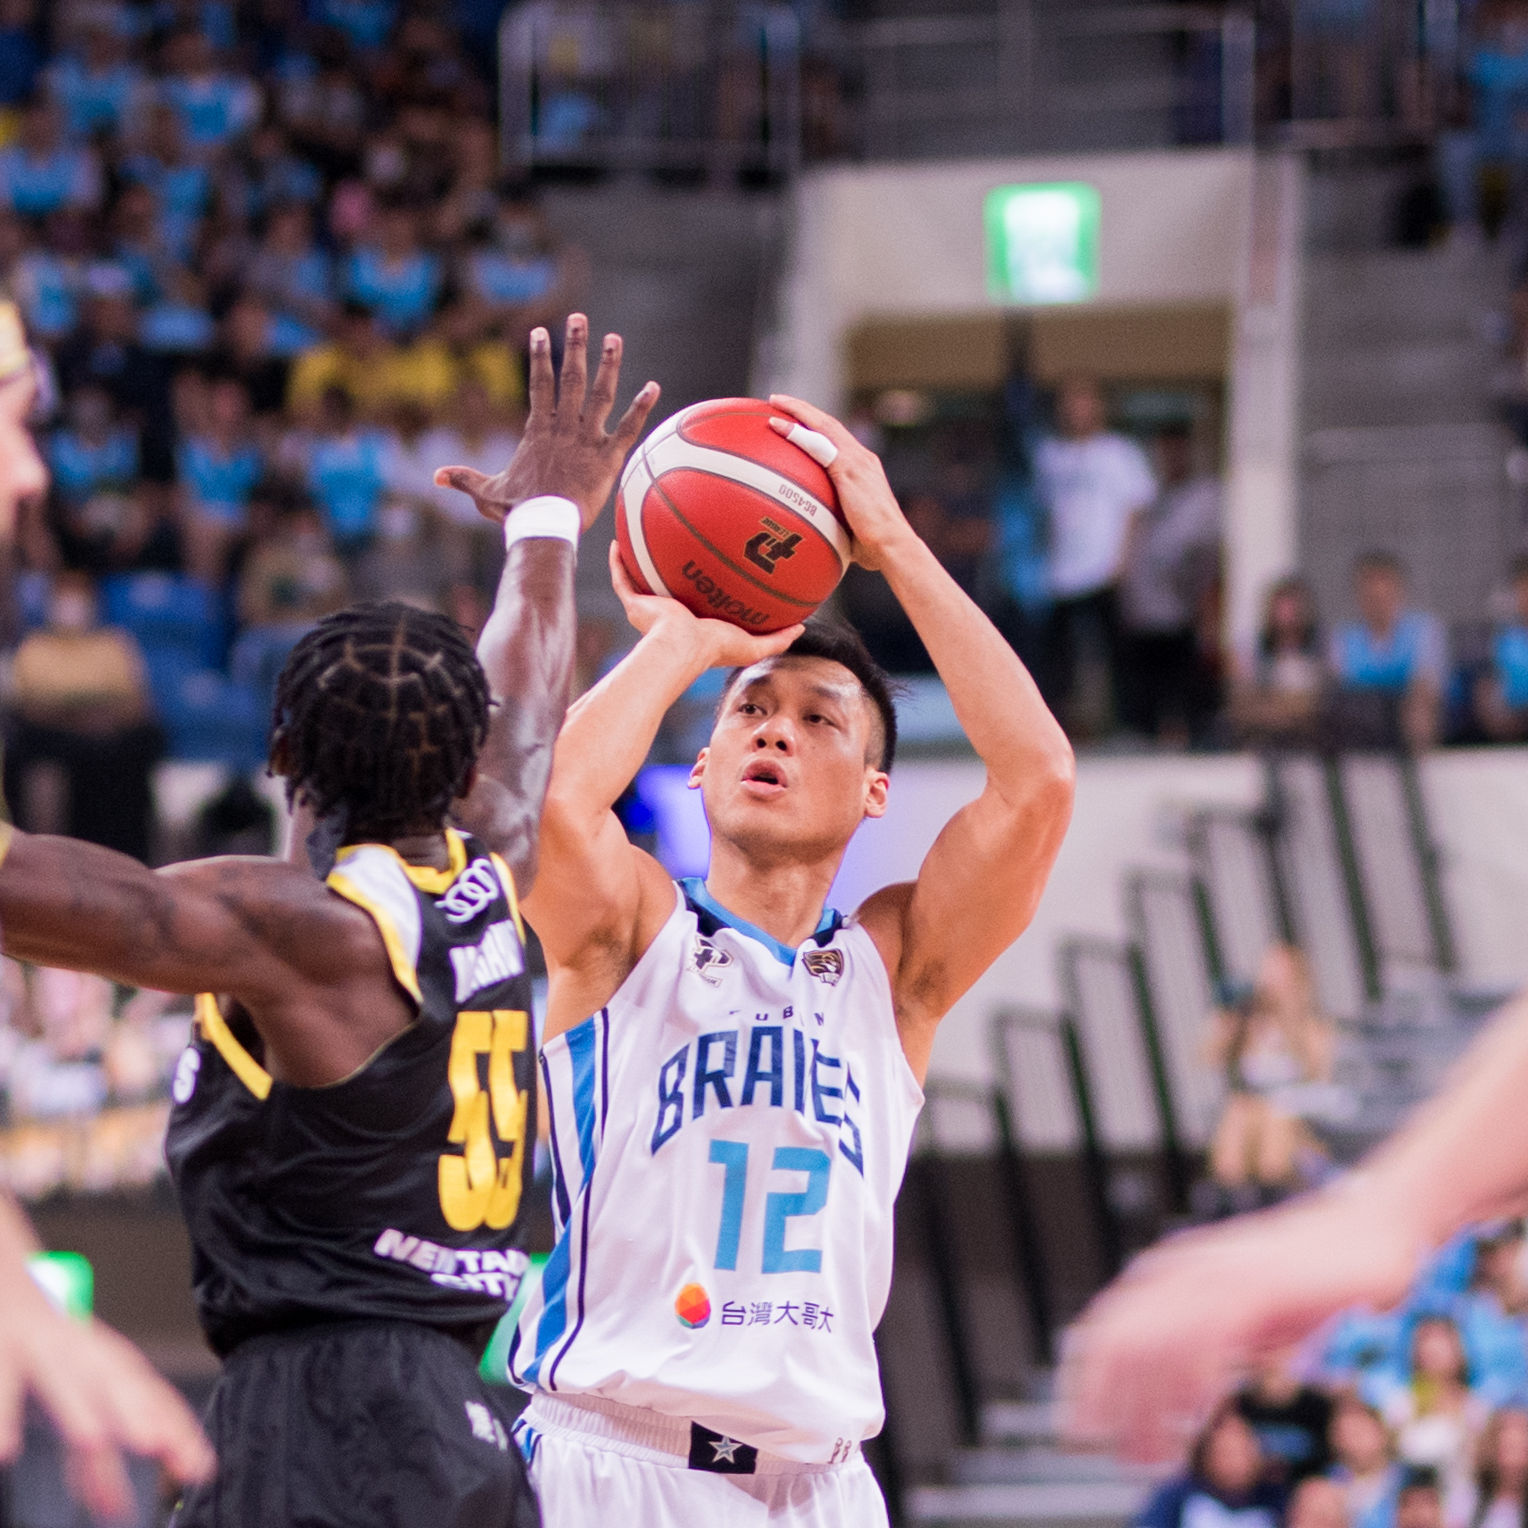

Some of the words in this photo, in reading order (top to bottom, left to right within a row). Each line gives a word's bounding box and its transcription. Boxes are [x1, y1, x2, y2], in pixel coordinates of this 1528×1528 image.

[778, 484, 818, 517] BG4500
[682, 560, 769, 626] molten
[437, 1010, 529, 1231] 55
[707, 1139, 832, 1275] 12
[720, 1301, 835, 1333] 台灣大哥大
